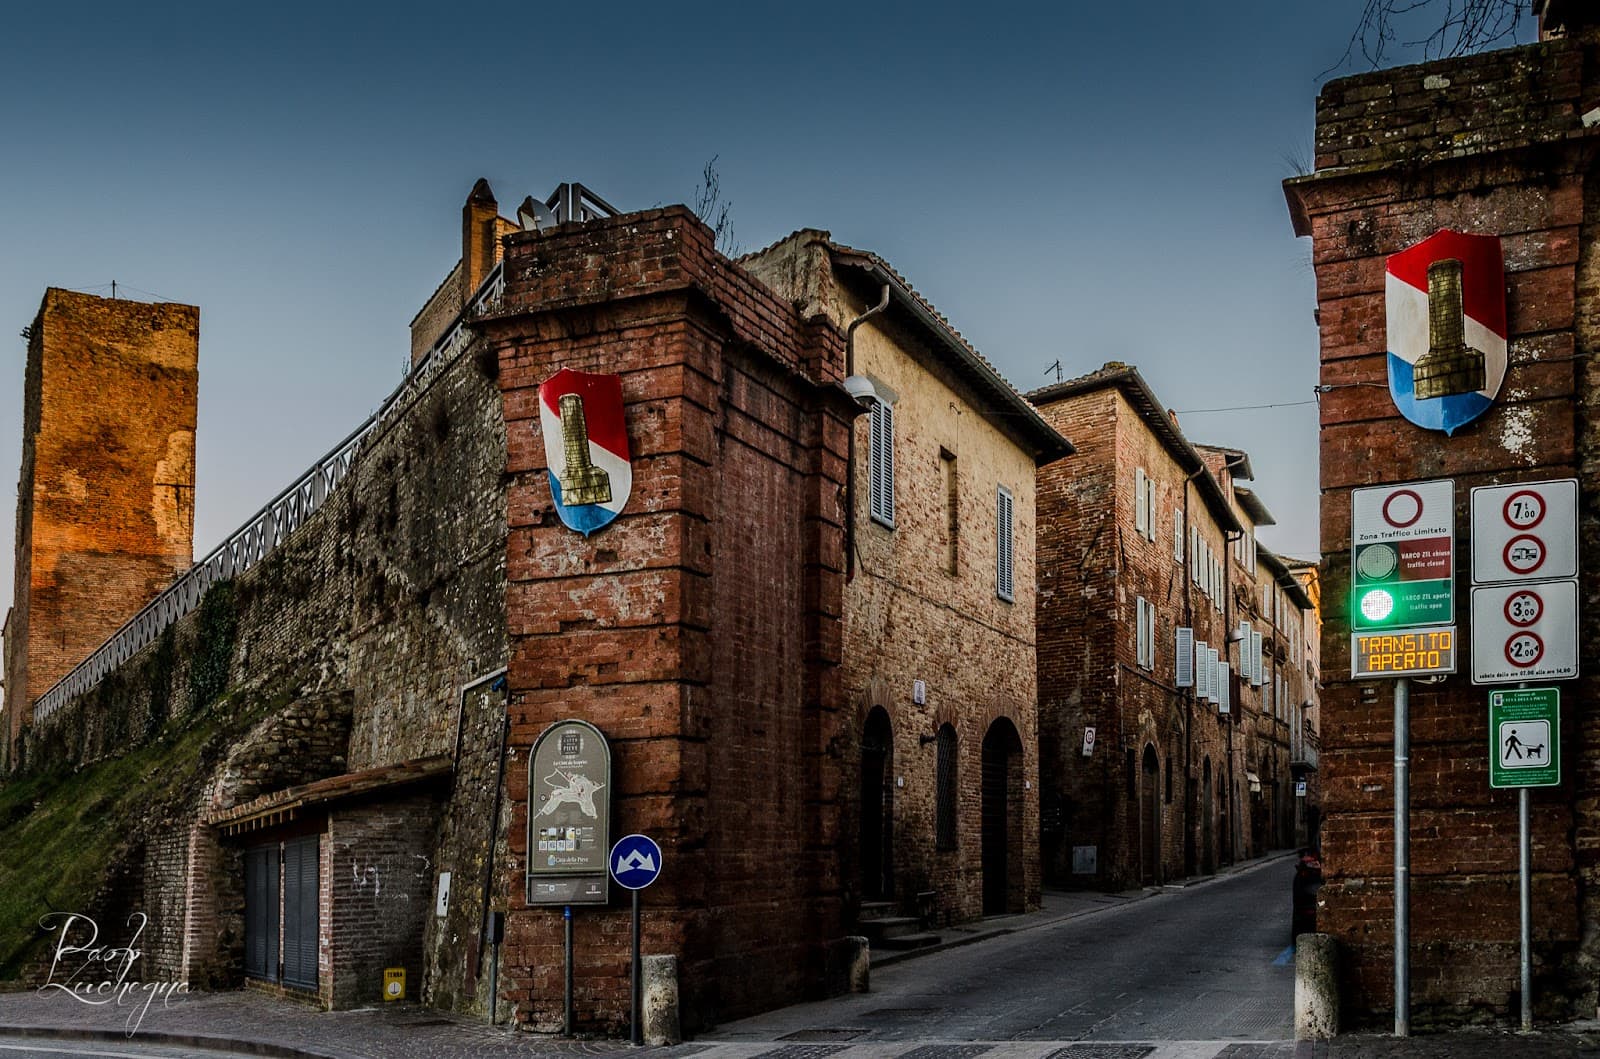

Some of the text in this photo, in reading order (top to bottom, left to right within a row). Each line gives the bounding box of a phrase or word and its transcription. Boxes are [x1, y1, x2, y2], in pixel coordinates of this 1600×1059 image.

[1360, 527, 1447, 541] Zona Traffico Limitato
[1401, 551, 1421, 560] VARCO
[1407, 561, 1425, 569] traffic
[1360, 632, 1451, 653] TRANSITO
[1369, 651, 1440, 671] APERTO
